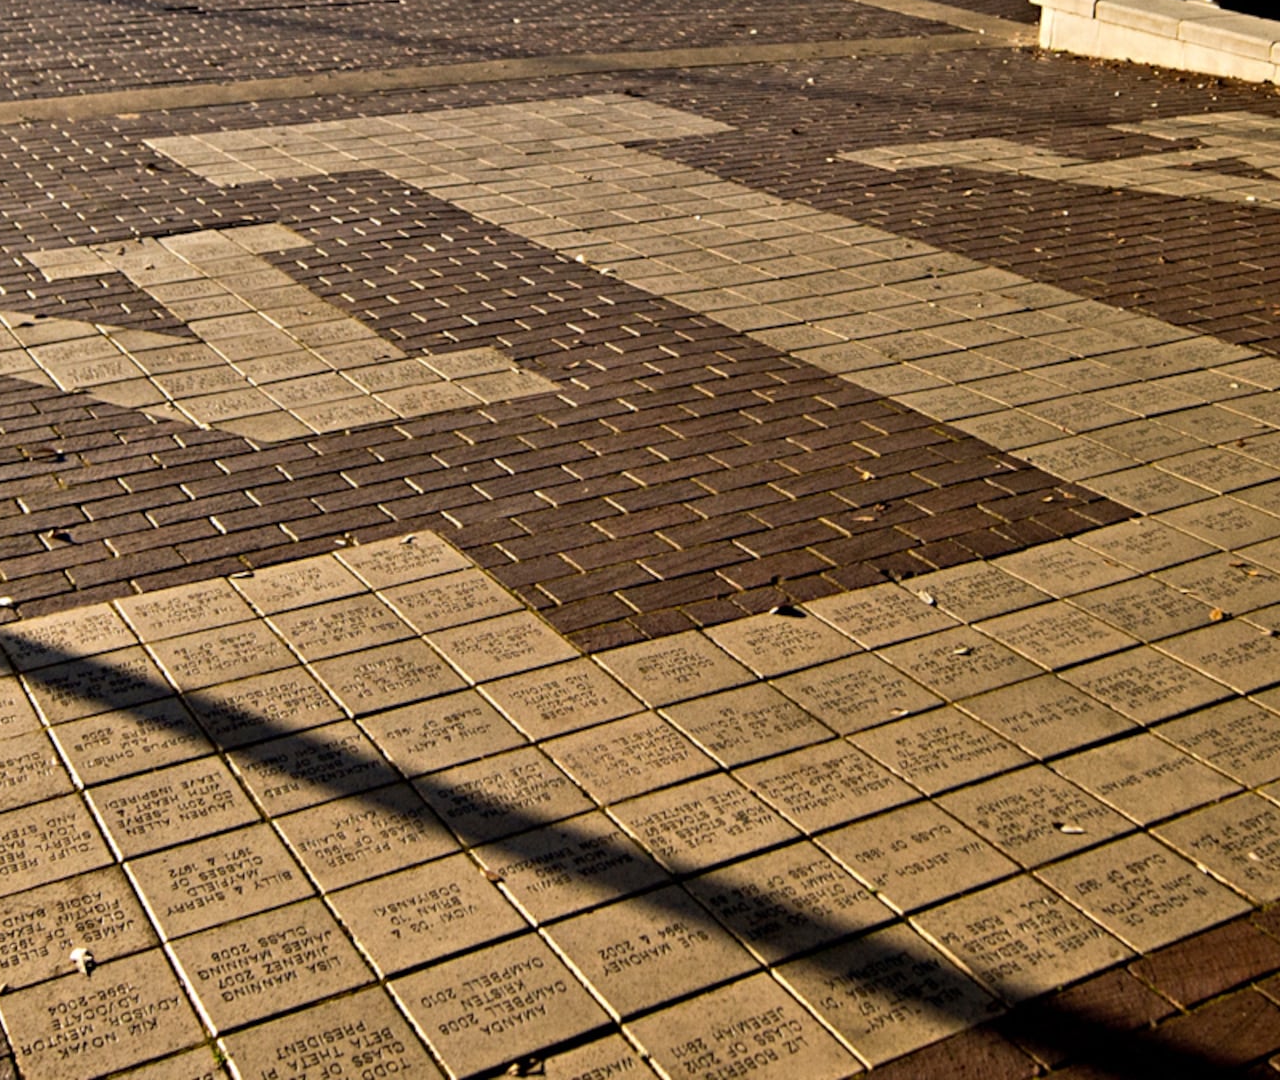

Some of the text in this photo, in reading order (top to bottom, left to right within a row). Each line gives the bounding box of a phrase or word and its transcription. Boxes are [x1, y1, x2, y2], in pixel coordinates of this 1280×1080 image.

[165, 861, 199, 879] 1972
[166, 853, 265, 891] CLASSES OF
[223, 845, 253, 862] 1971
[184, 867, 261, 898] MAYFIELD
[248, 868, 296, 891] BILLY
[162, 890, 227, 918] SHERRY
[206, 923, 309, 964] CLASS 2008
[652, 919, 691, 940] 1994
[195, 927, 339, 982] JAMES MANNING
[212, 943, 331, 991] JIMENEZ 2007
[594, 939, 636, 961] 2002
[598, 928, 711, 976] SUE MAHONEY
[218, 953, 347, 1004] LISA MANNING
[416, 956, 545, 1010] CAMPBELL 2010
[457, 977, 528, 1011] KRISTEN
[48, 992, 142, 1032] ADVOCATE
[433, 979, 569, 1037] CAMPBELL 2008
[477, 1002, 550, 1038] AMANDA
[17, 1021, 99, 1058] MENTOR
[56, 1016, 161, 1060] KIM NOVAK
[257, 1026, 396, 1080] BETA THETA PI
[271, 1019, 369, 1061] PRESIDENT
[315, 1038, 408, 1080] CLASS OF
[357, 1054, 413, 1080] TODD
